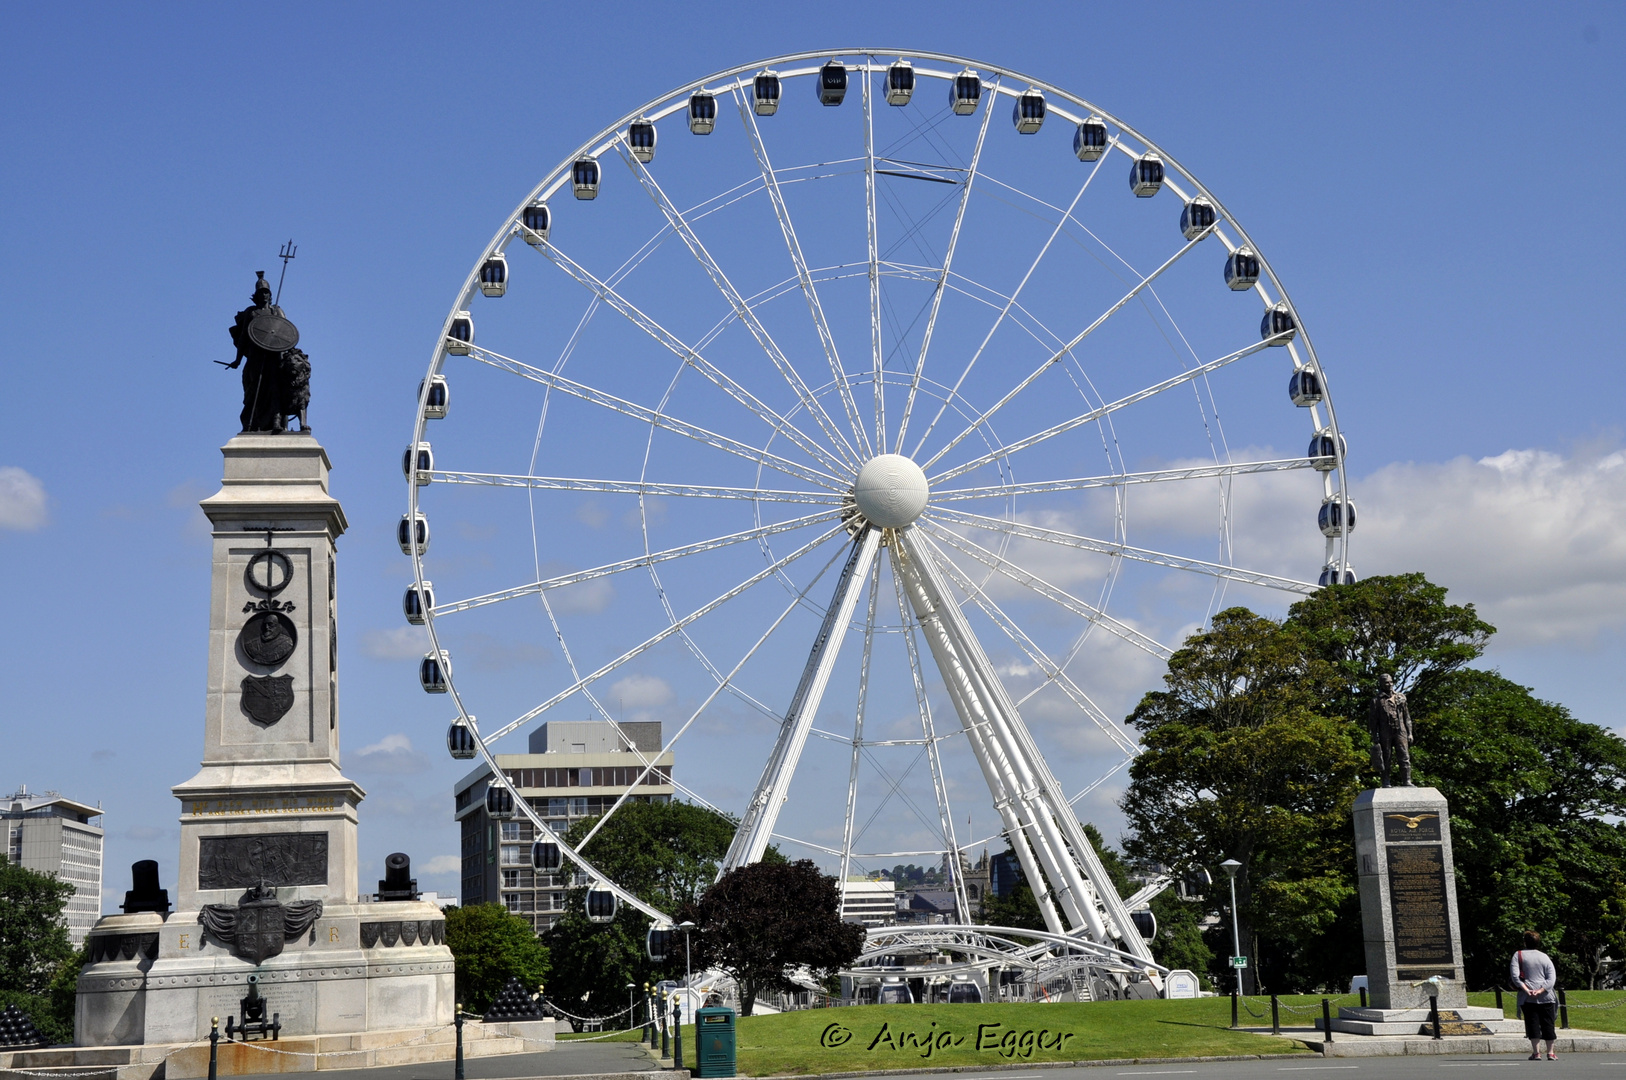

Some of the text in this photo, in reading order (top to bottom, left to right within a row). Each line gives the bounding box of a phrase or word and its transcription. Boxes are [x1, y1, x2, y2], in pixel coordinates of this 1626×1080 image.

[217, 800, 243, 808] BLEW
[306, 796, 334, 804] WINDS
[254, 807, 278, 815] WERE
[281, 805, 334, 813] SCATTERED
[178, 926, 340, 949] E R
